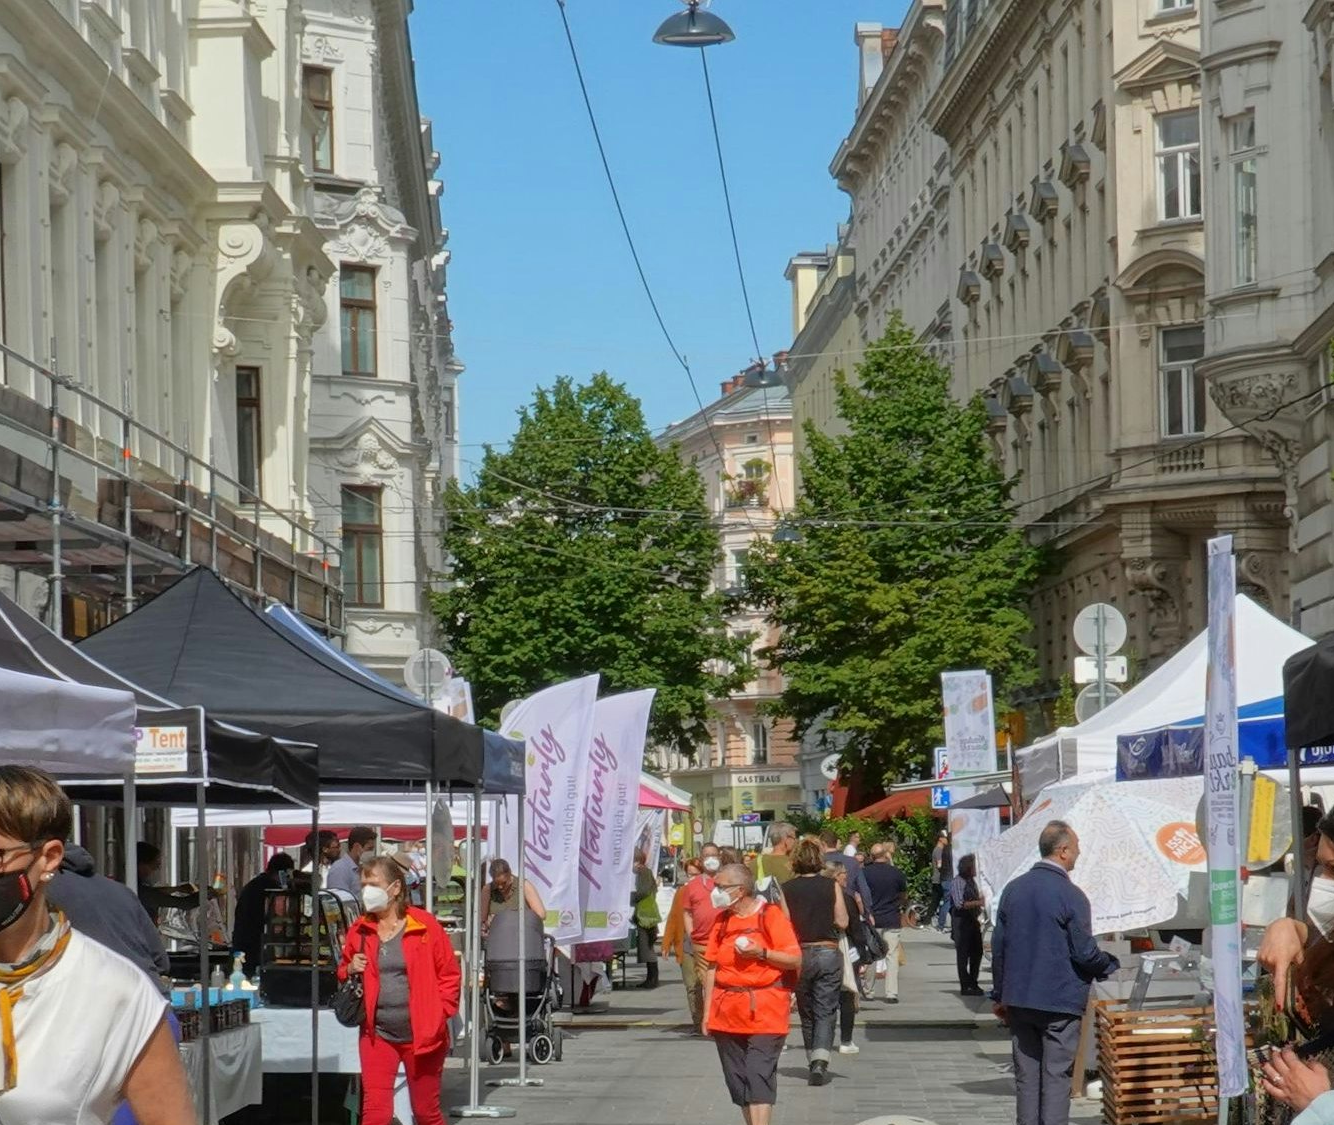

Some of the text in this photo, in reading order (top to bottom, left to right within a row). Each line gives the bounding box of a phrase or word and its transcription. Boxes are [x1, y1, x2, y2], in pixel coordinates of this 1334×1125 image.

[149, 728, 185, 749] Tent
[737, 775, 781, 784] GASTHAUS
[579, 732, 618, 891] Naturly
